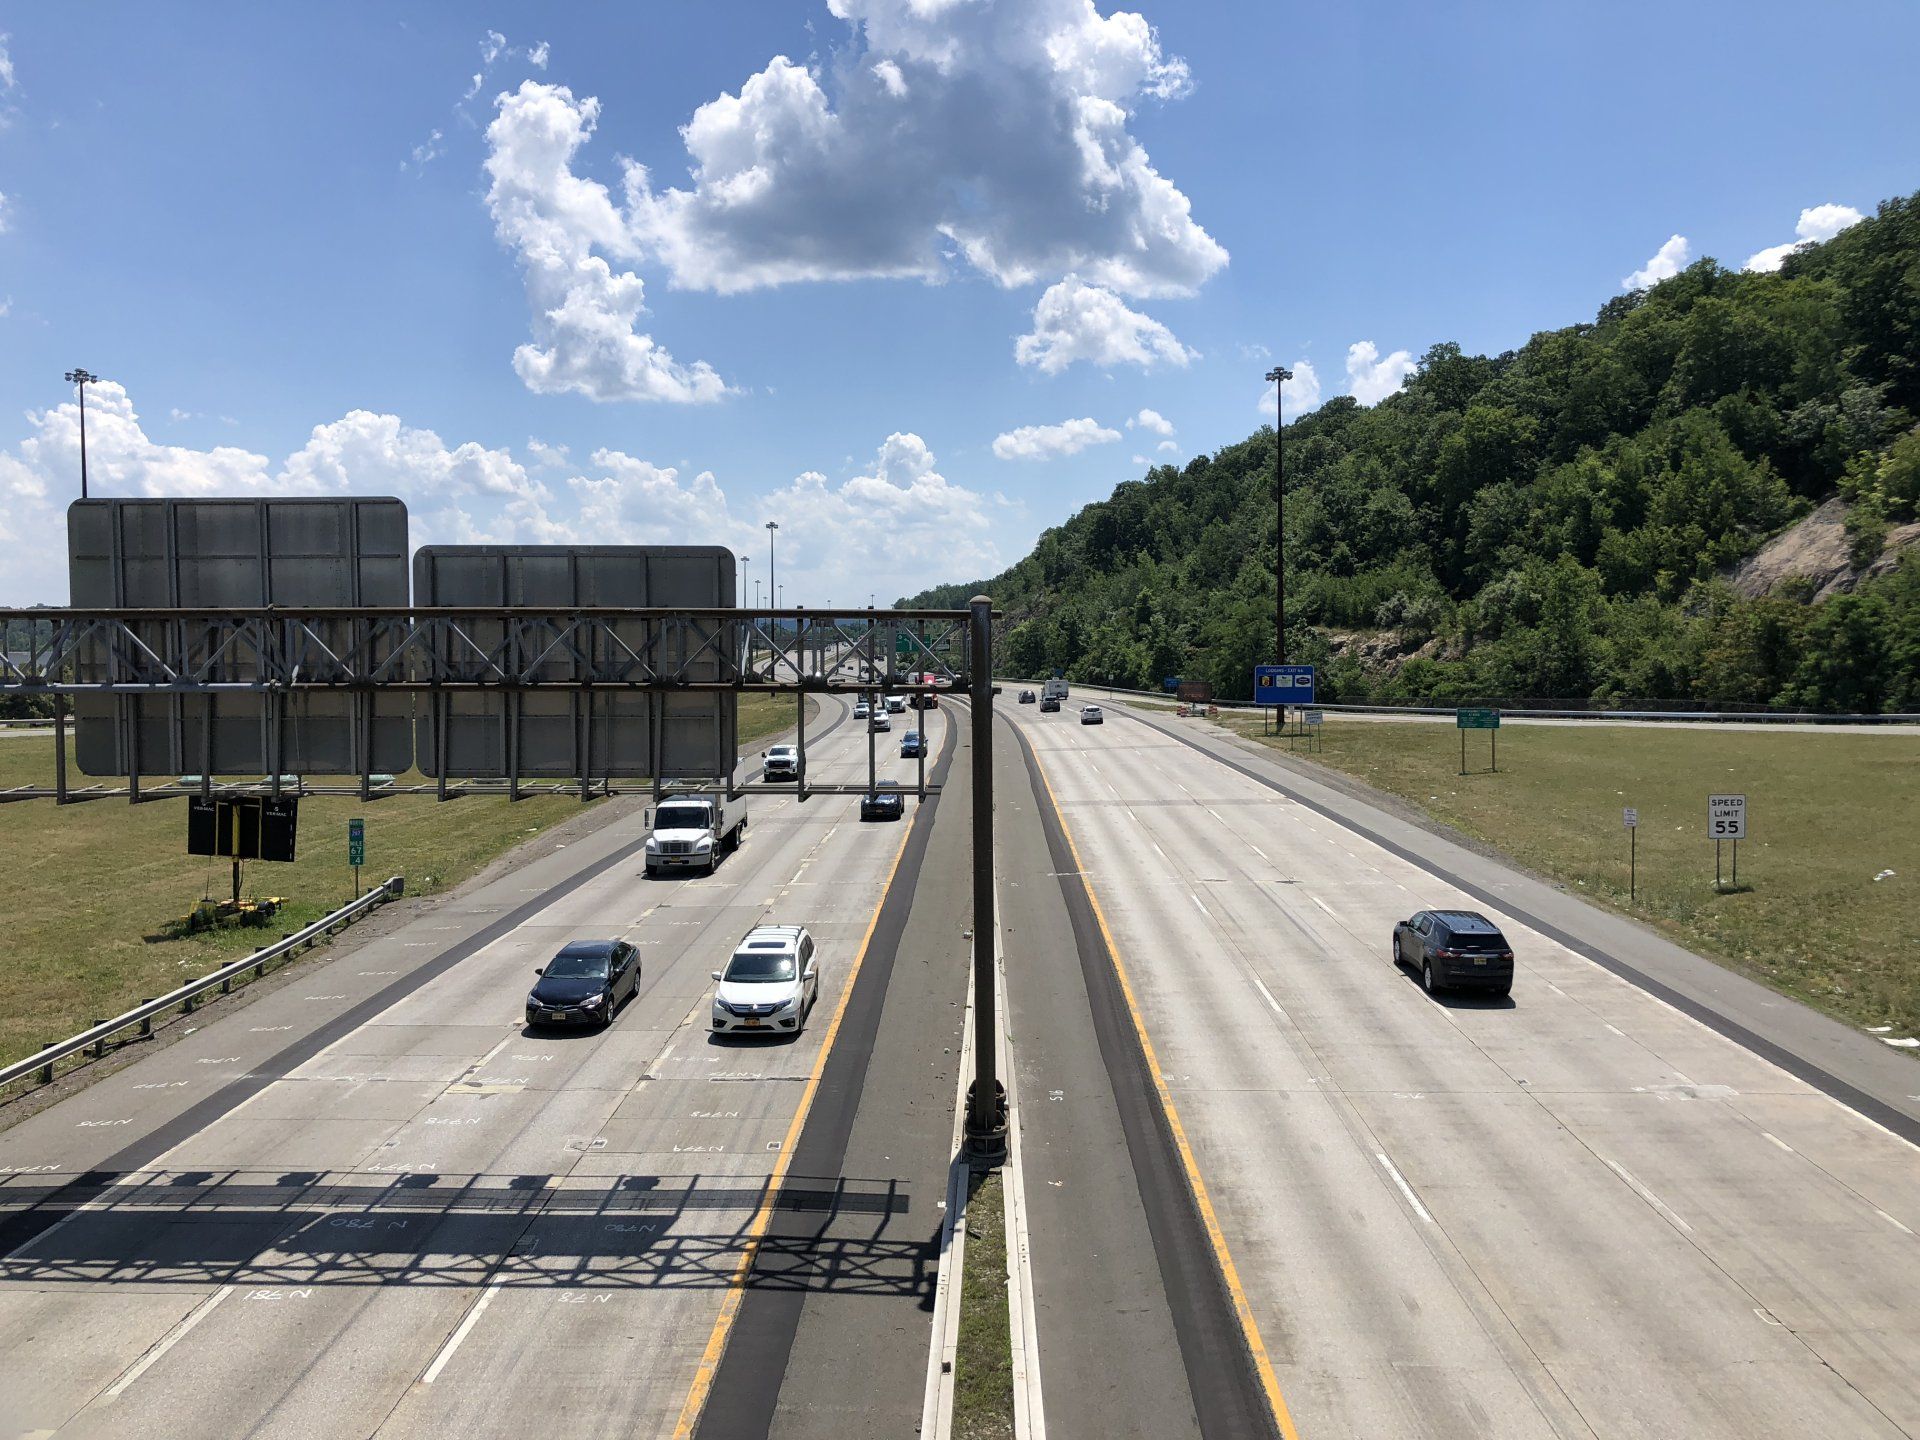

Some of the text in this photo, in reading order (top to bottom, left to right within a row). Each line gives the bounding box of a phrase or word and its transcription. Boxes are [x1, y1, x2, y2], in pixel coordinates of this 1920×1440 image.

[1711, 799, 1743, 807] SPEED
[1714, 810, 1740, 818] LIMIT
[1715, 821, 1739, 834] 55
[351, 847, 362, 855] 67
